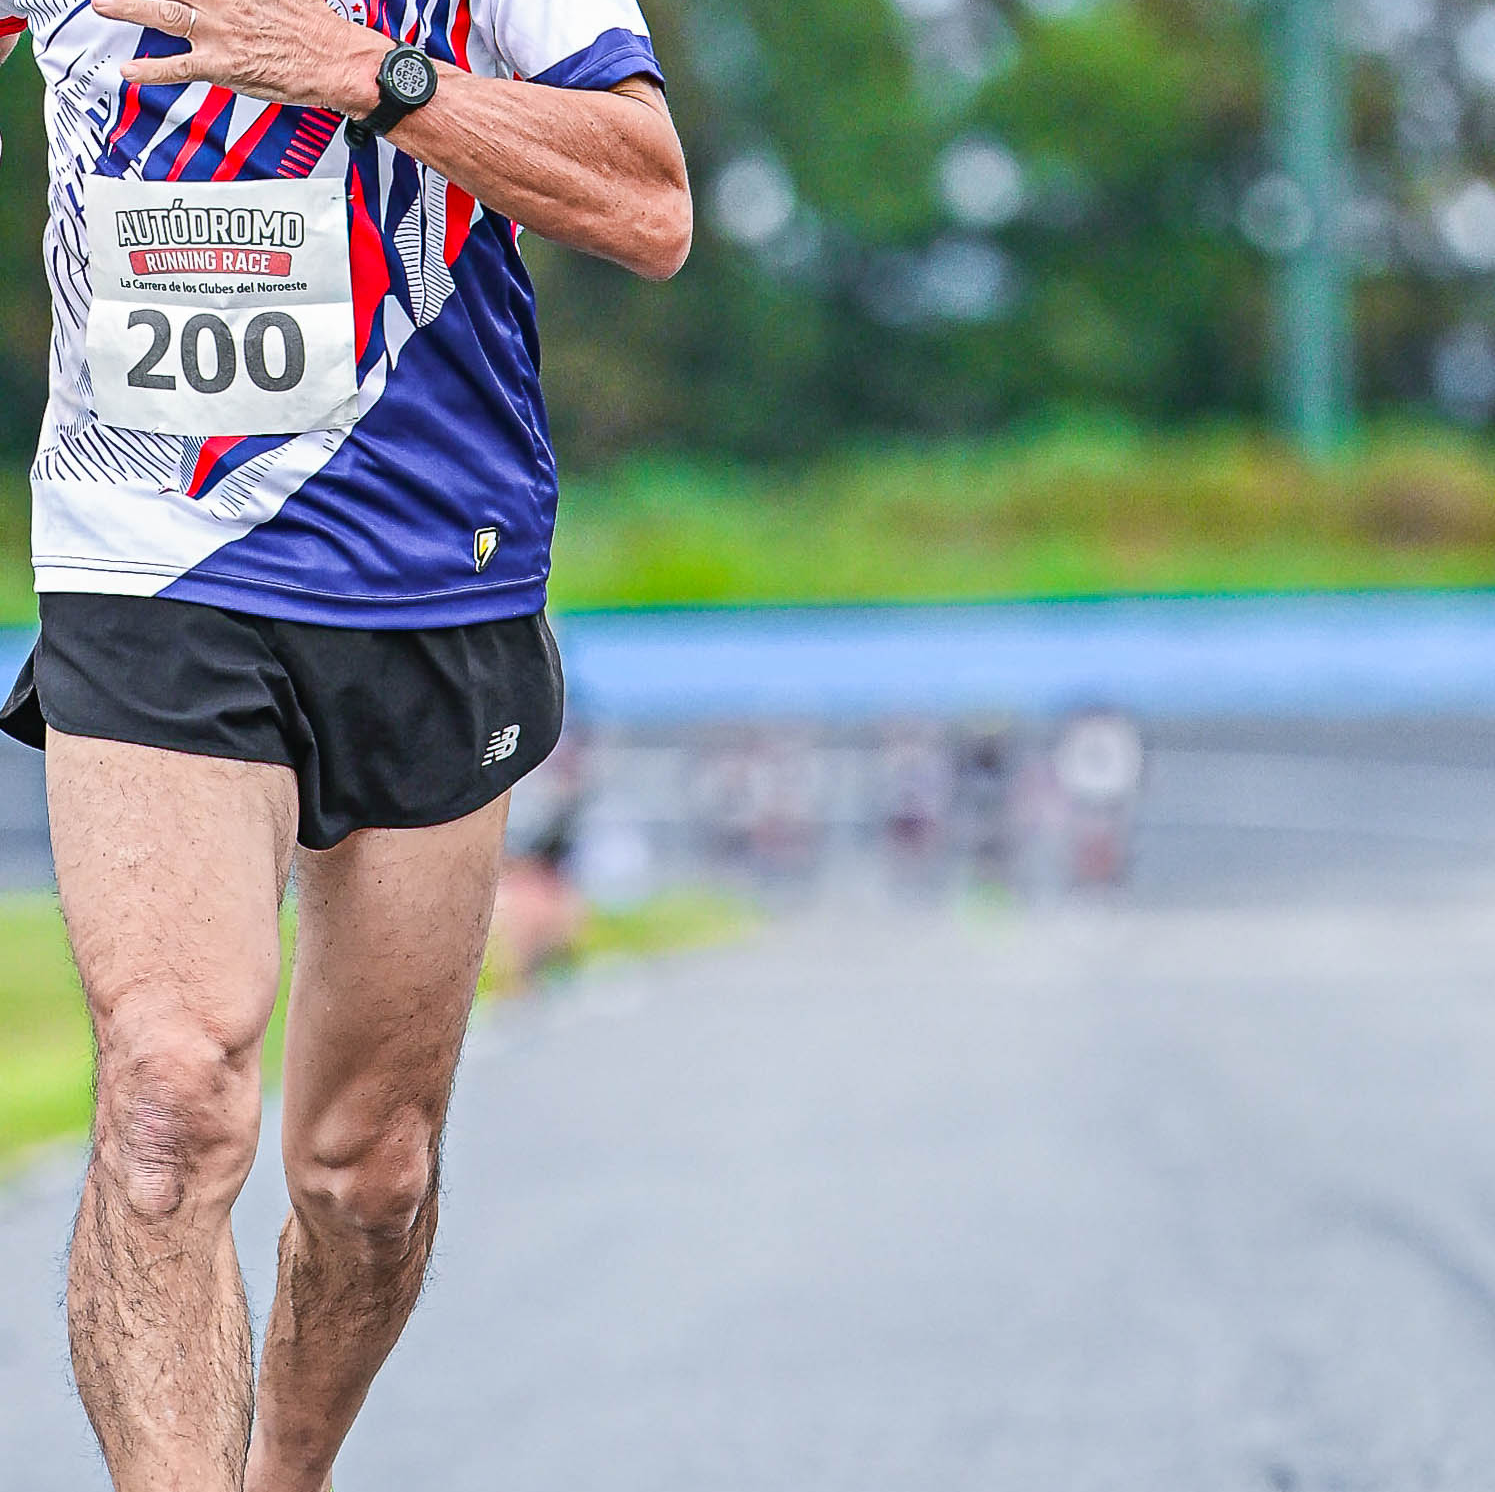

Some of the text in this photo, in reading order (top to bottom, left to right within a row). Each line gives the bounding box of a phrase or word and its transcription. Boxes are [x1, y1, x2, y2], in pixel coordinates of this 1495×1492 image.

[395, 67, 425, 88] 25:39
[403, 59, 424, 76] 5:55
[115, 198, 304, 247] AUTÓDROMO
[145, 251, 271, 273] RUNNING RACE
[120, 277, 308, 295] La Carrera de los Clubes del Noroeste
[127, 309, 306, 394] 200
